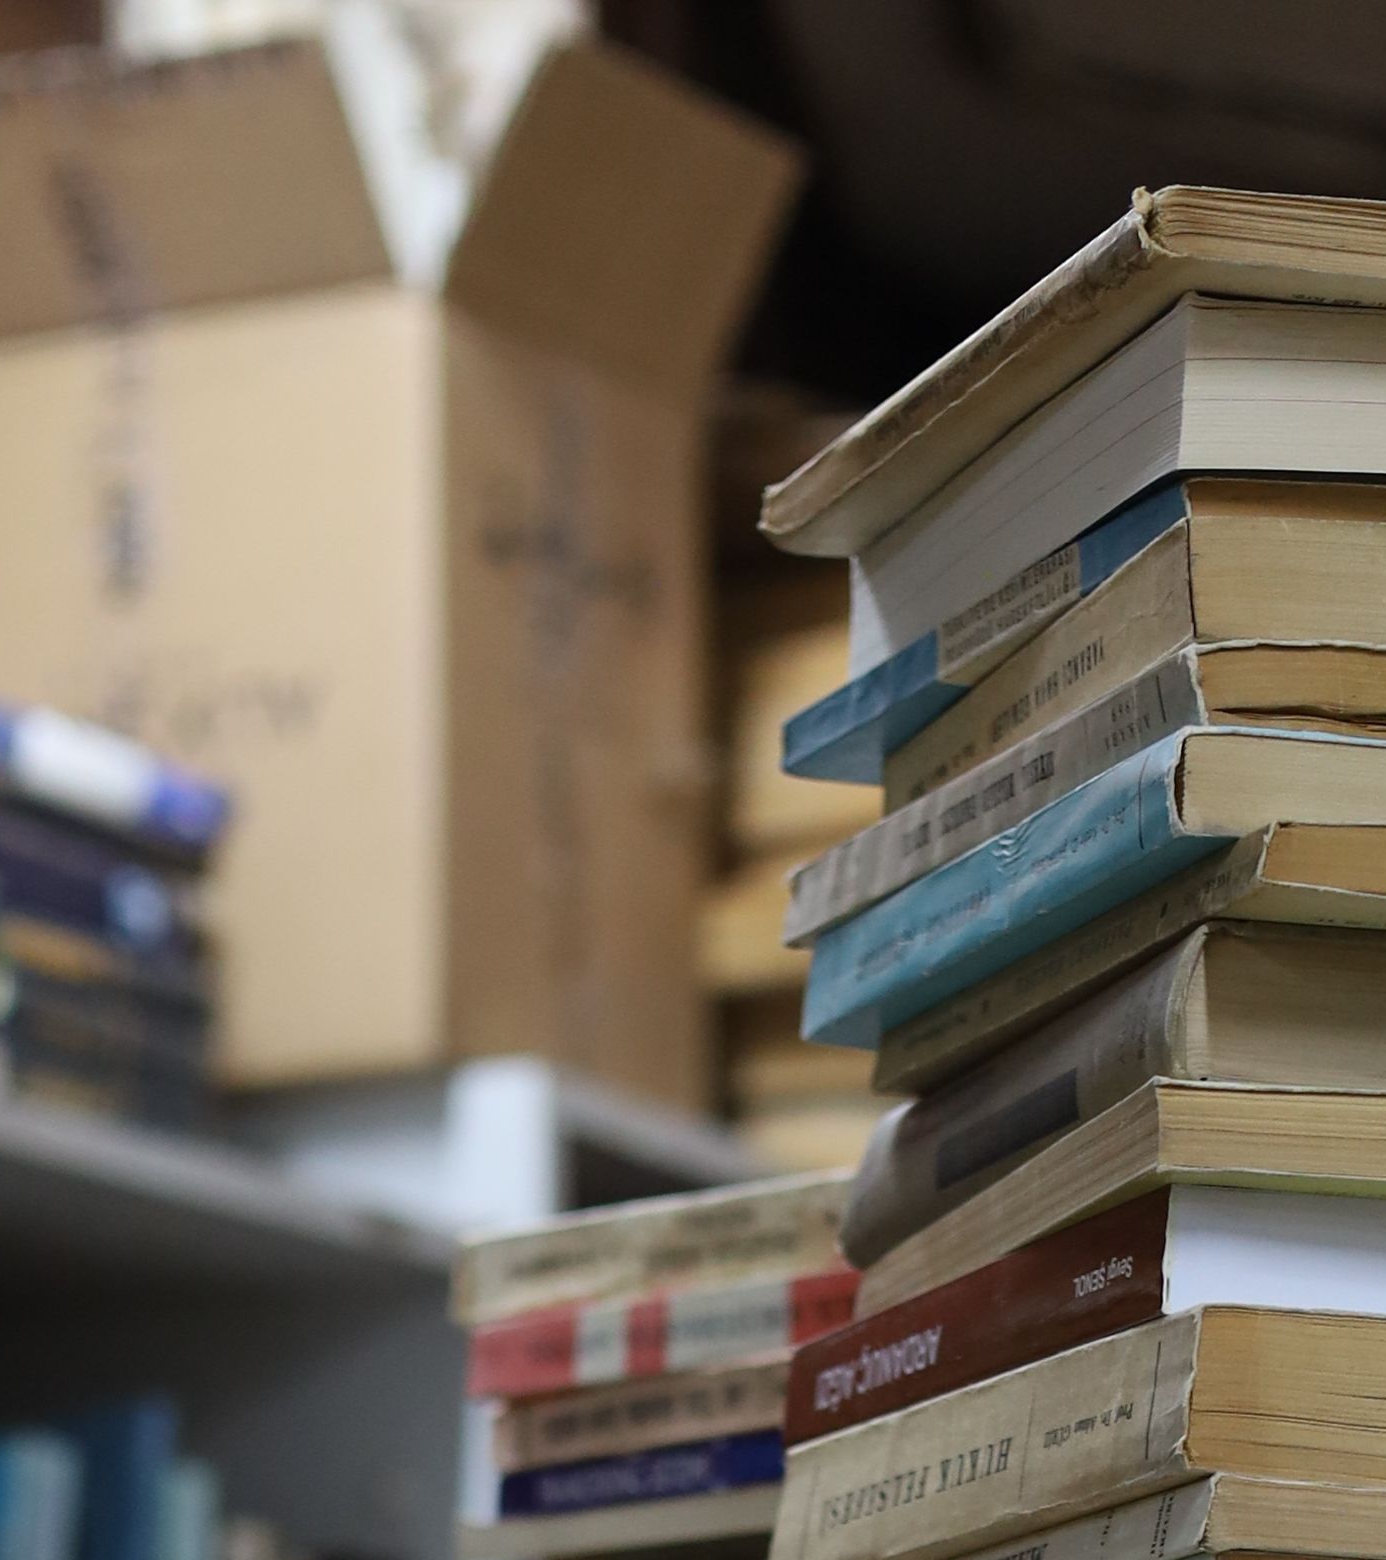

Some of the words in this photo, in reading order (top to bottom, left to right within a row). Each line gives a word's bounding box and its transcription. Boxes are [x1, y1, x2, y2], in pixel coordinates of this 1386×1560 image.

[1073, 1262, 1106, 1298] ŞENOL
[1106, 1256, 1133, 1284] Sevgi
[936, 1438, 1012, 1492] HUKUK
